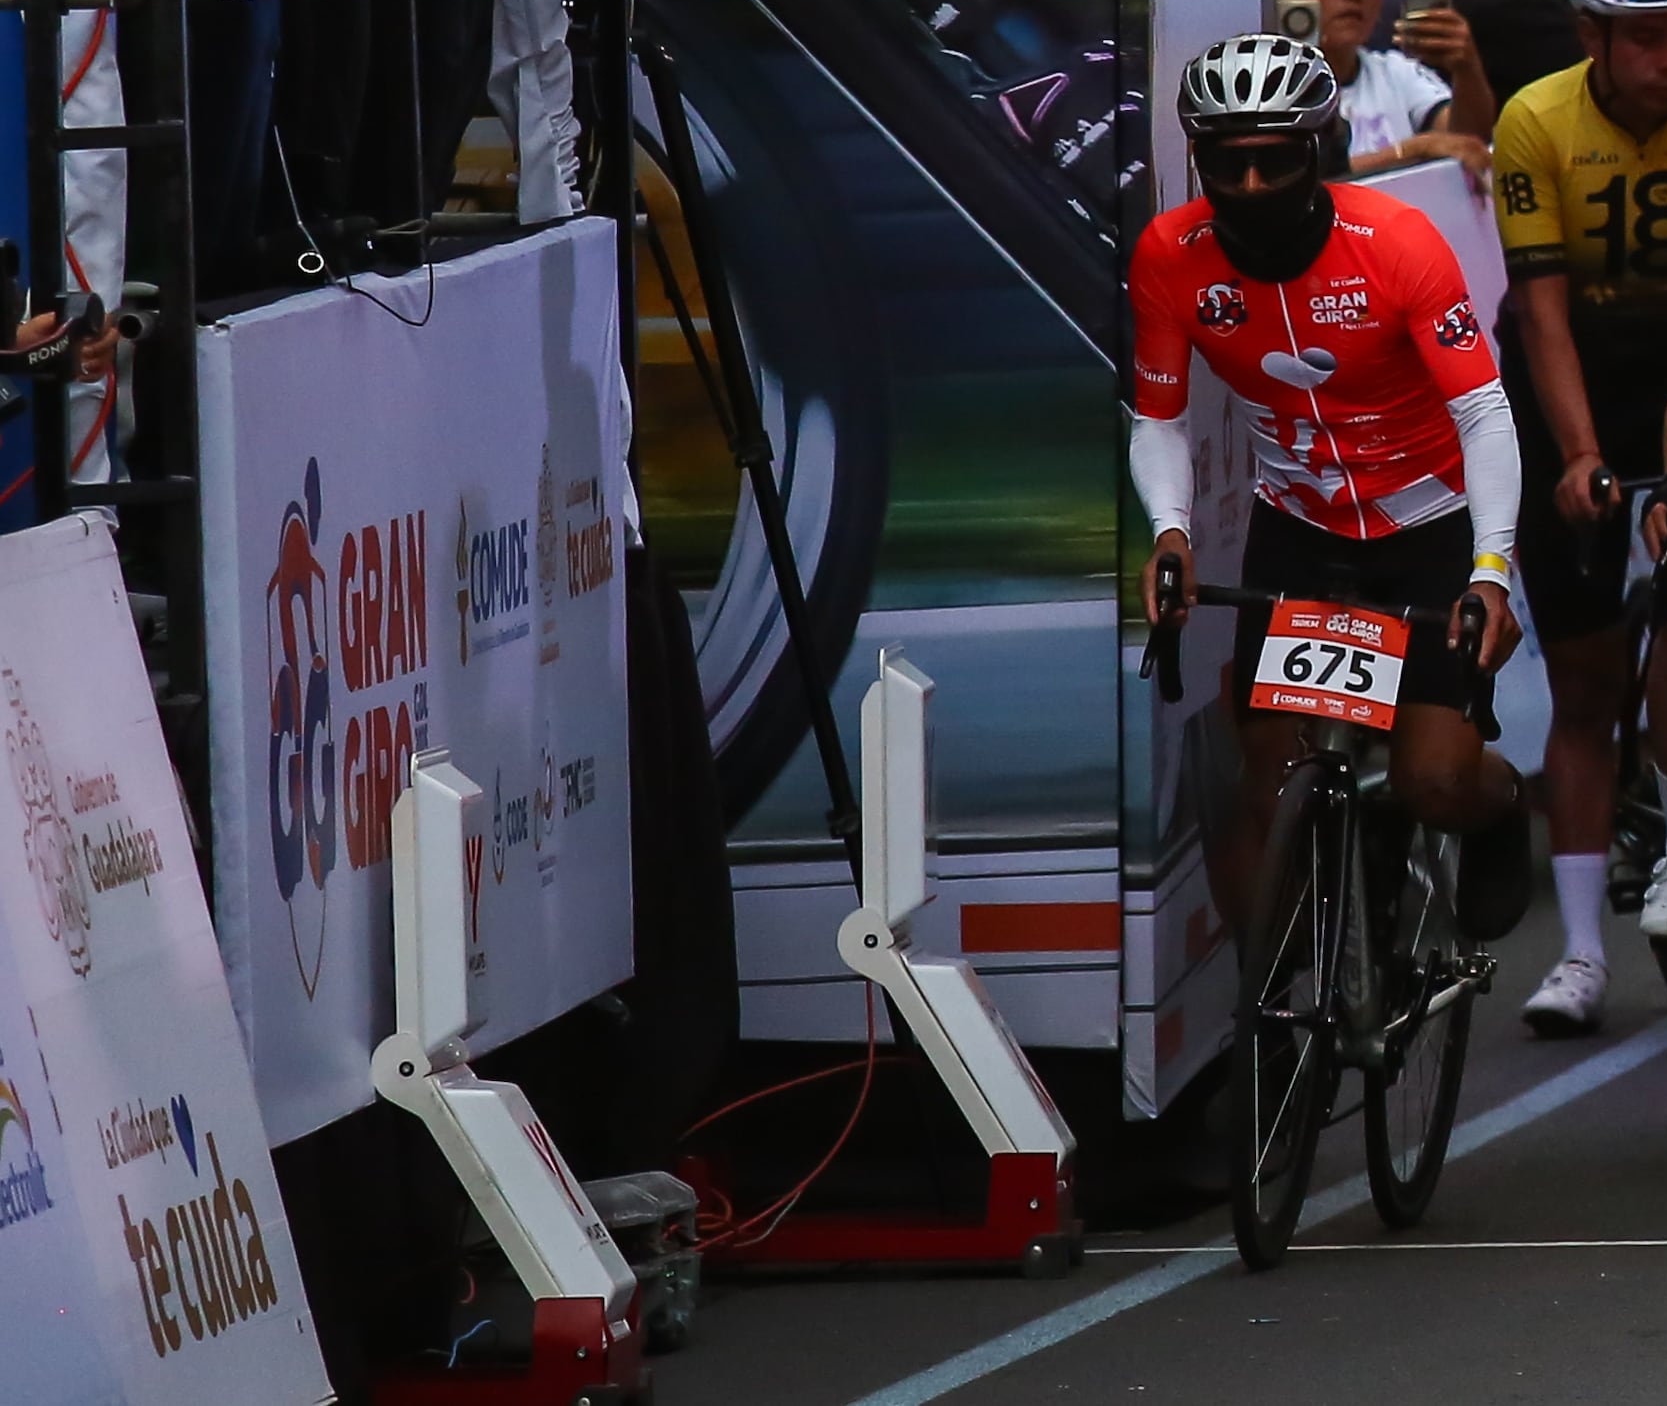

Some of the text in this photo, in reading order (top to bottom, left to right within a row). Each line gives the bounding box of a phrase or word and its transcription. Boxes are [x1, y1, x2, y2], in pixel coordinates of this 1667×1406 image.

[1309, 291, 1368, 311] GRAN
[1311, 310, 1359, 325] GIRO
[28, 335, 70, 365] RONIN
[1142, 368, 1179, 385] uida
[470, 518, 530, 625] COMUDE
[338, 509, 428, 693] GRAN
[1350, 618, 1384, 635] GRAN
[1283, 641, 1376, 694] 675
[82, 817, 163, 898] Guadalajara
[118, 1130, 278, 1358] te cuida
